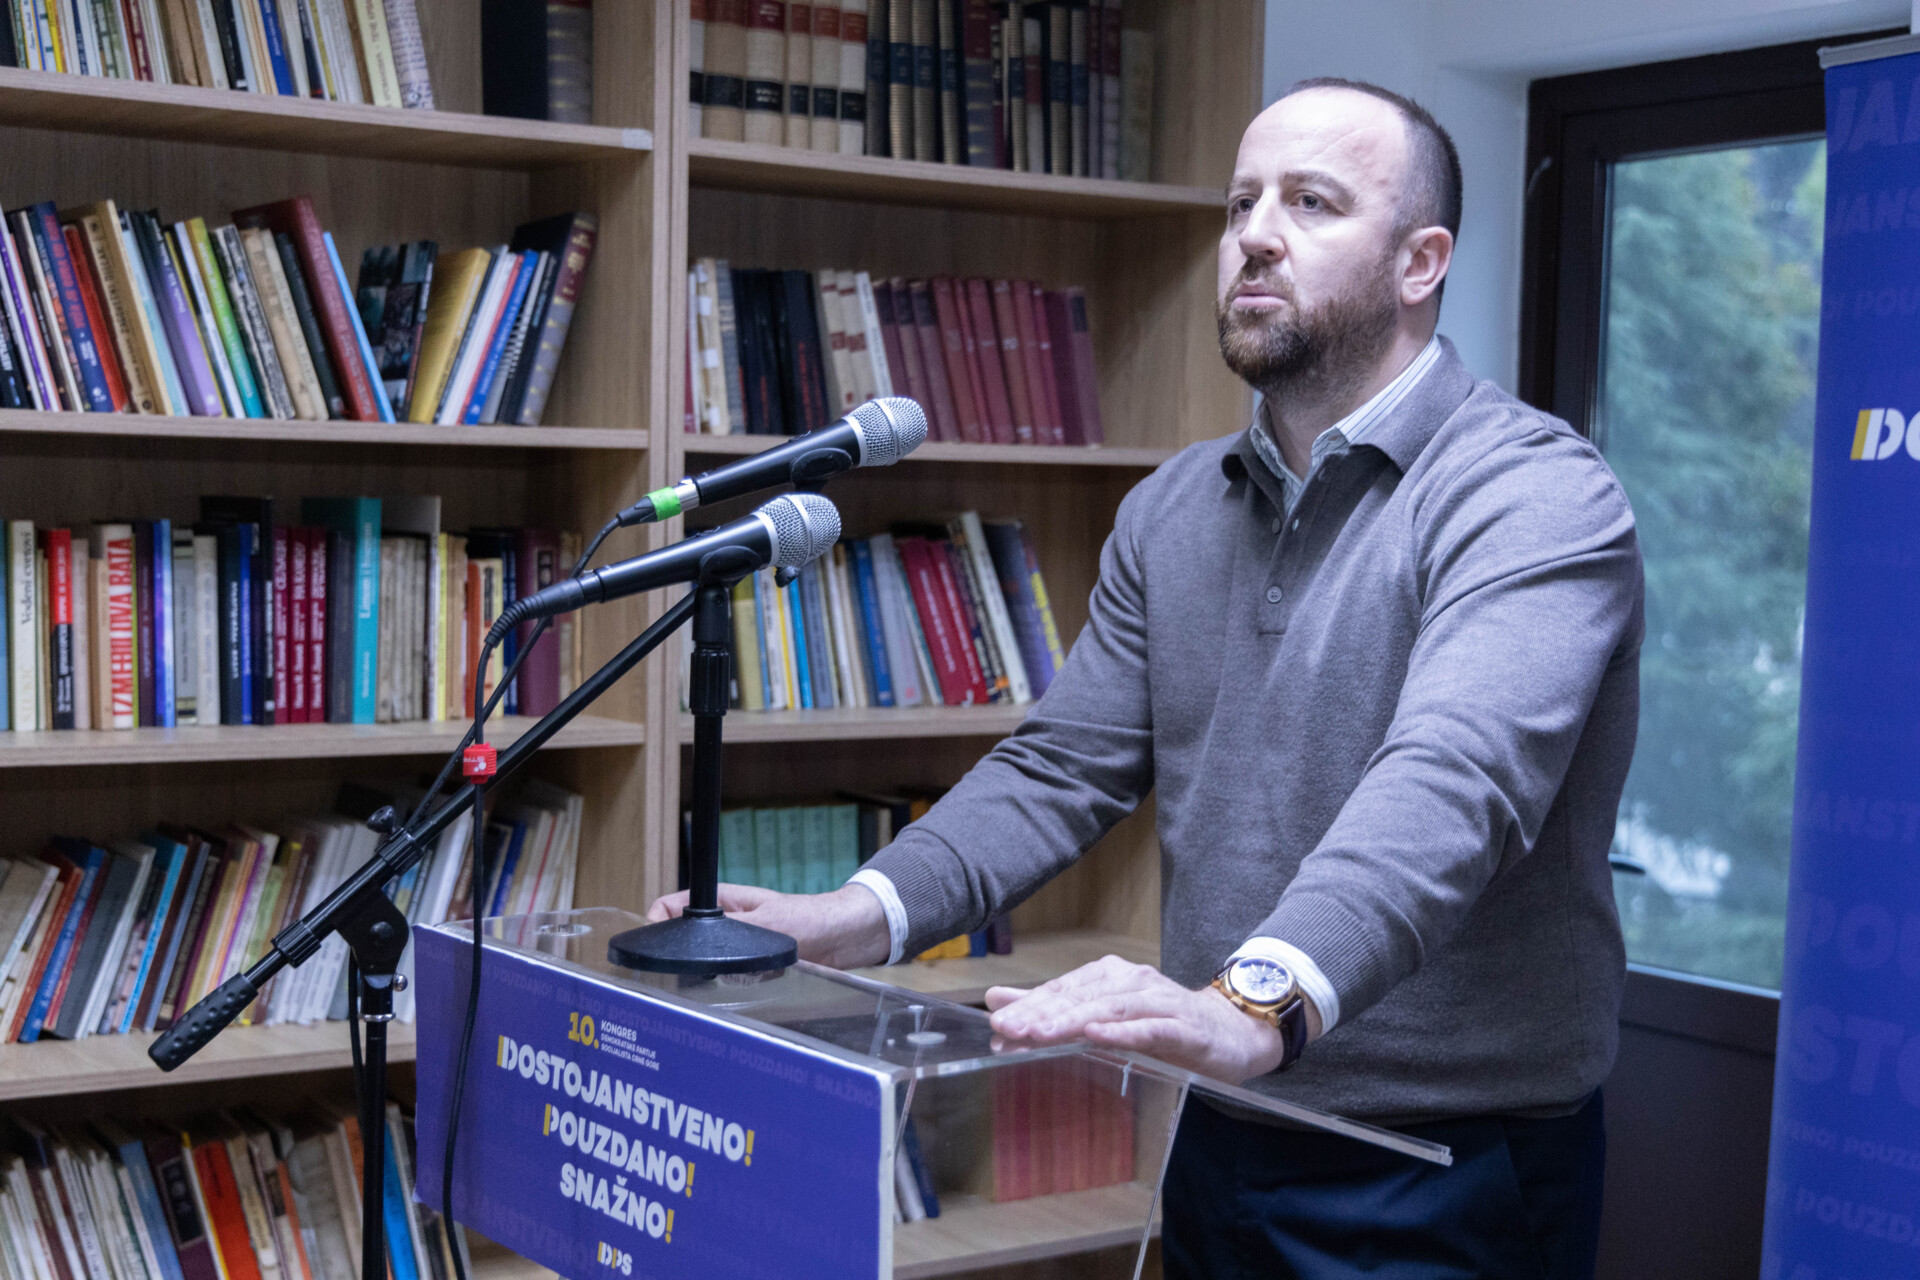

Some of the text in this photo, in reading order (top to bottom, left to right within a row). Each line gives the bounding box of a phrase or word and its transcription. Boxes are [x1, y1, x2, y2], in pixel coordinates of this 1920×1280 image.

[108, 537, 132, 586] RATA
[568, 1012, 599, 1050] 10.
[601, 1019, 637, 1042] KONGRES
[601, 1033, 657, 1060] DEMOKRATSKE PARTIJE
[601, 1043, 660, 1072] SOCIJALISTA CRNE GORE
[497, 1034, 755, 1167] DOSTOJANSTVENO!
[543, 1103, 696, 1198] POUZDANO!
[560, 1162, 675, 1244] SNAŽNO!
[597, 1240, 633, 1276] DPS
